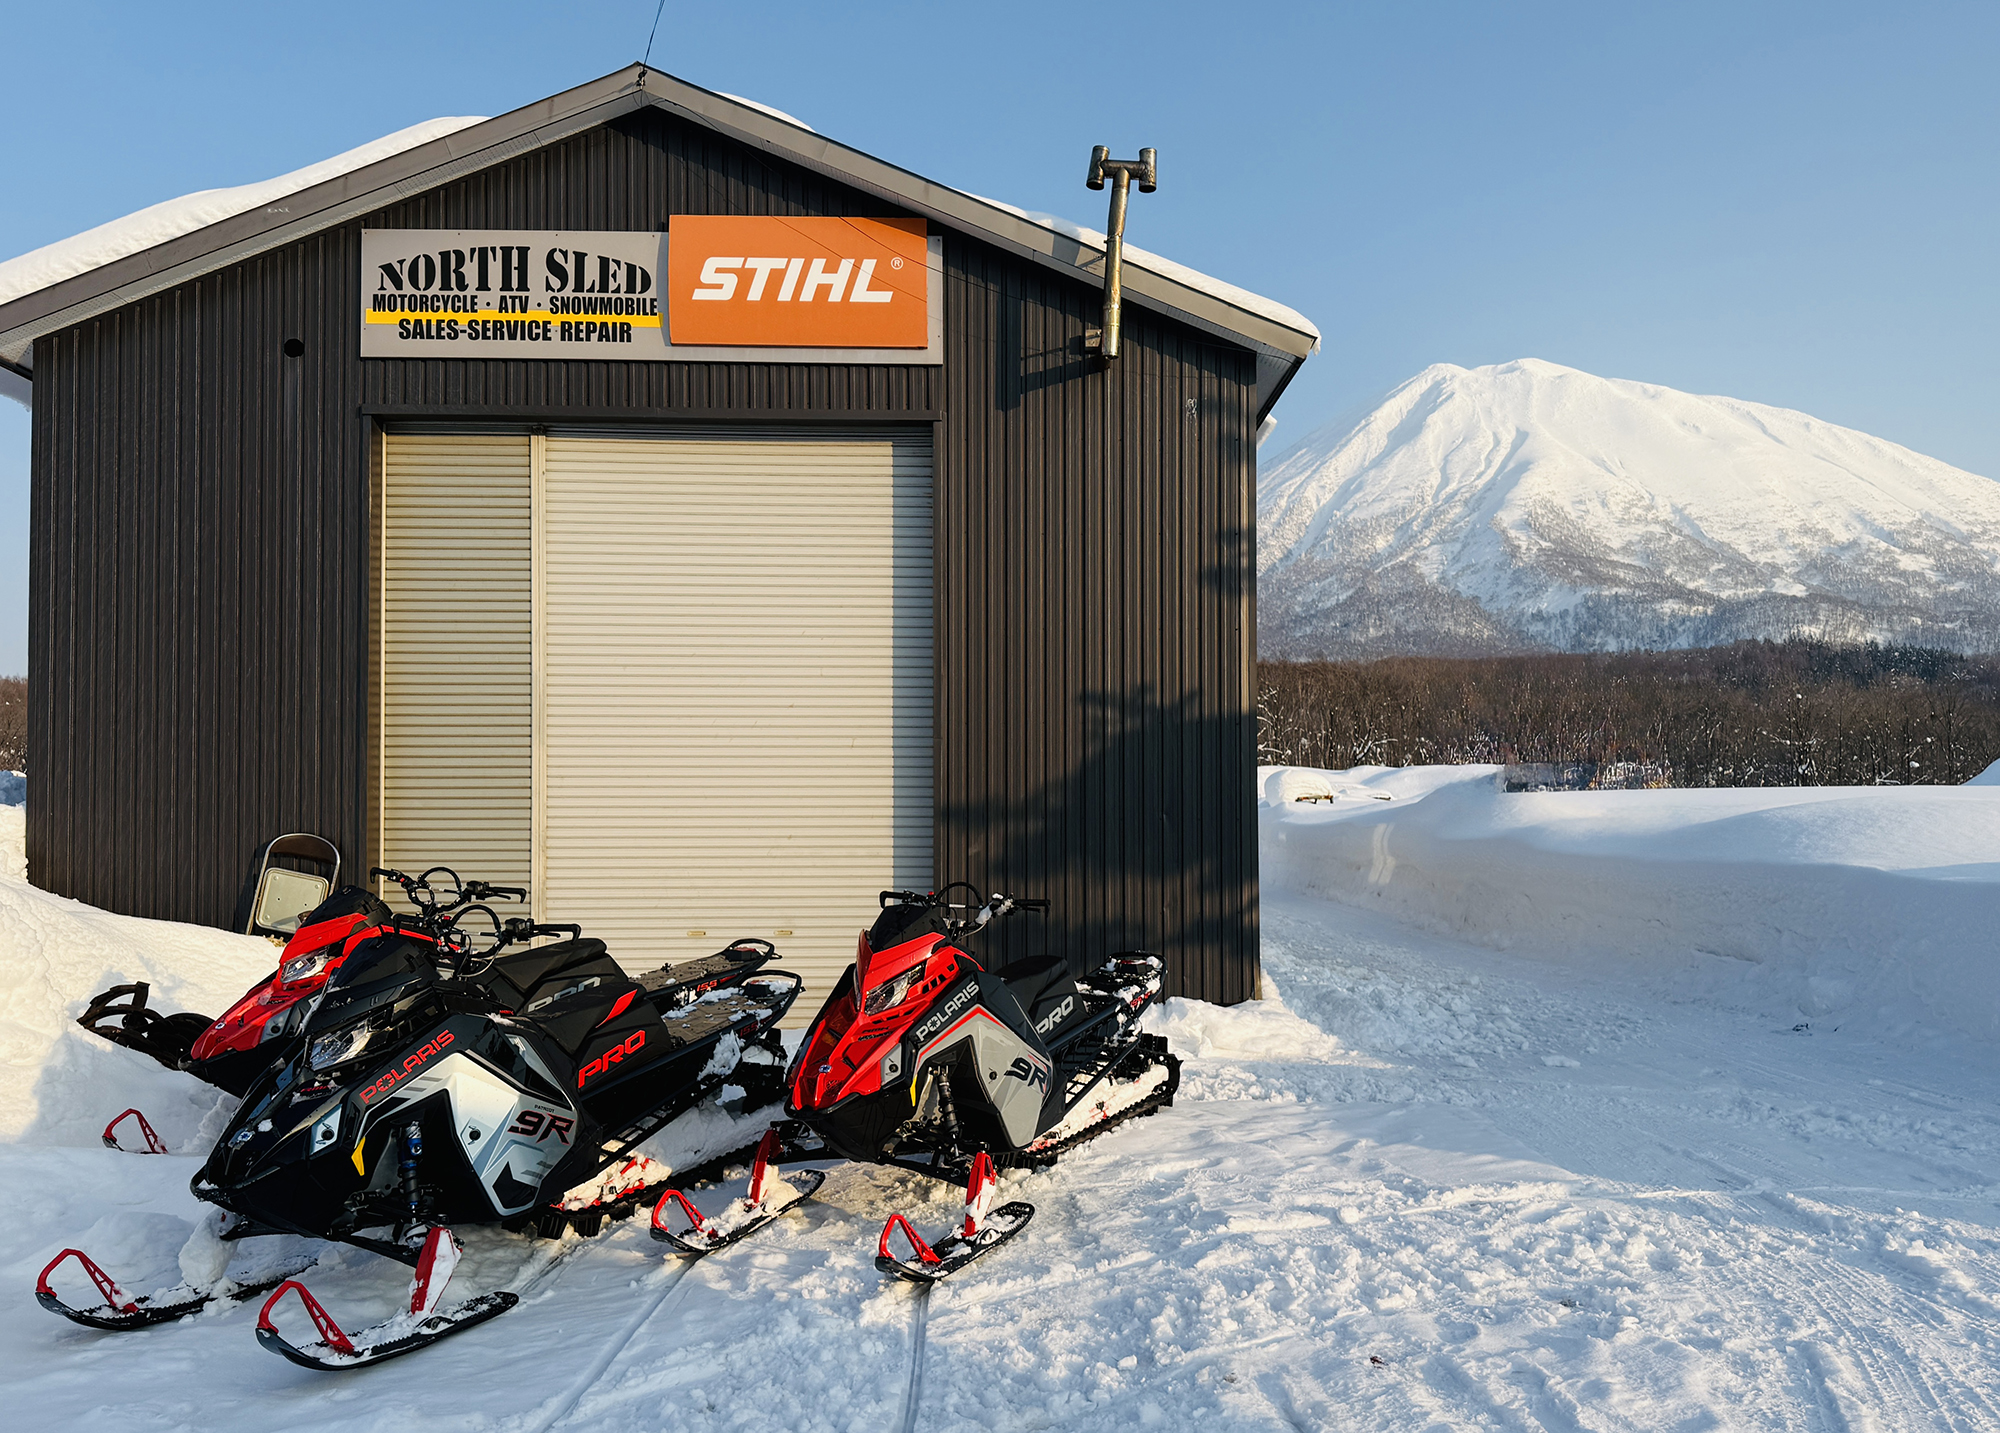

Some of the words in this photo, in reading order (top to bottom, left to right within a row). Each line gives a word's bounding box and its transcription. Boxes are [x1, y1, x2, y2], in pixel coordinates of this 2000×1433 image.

[377, 246, 530, 292] NORTH
[545, 247, 652, 294] SLED
[691, 256, 893, 302] STIHL
[372, 293, 478, 313] MOTORCYCLE
[498, 295, 529, 314] ATV
[549, 295, 658, 317] SNOWMOBILE
[398, 318, 552, 341] SALES-SERVICE
[560, 321, 632, 343] REPAIR
[916, 981, 979, 1042] POLARIS
[1035, 995, 1074, 1035] PRO
[359, 1029, 455, 1104] POLARIS
[578, 1030, 646, 1089] PRO
[1004, 1056, 1048, 1095] 9R
[507, 1109, 575, 1145] 9R
